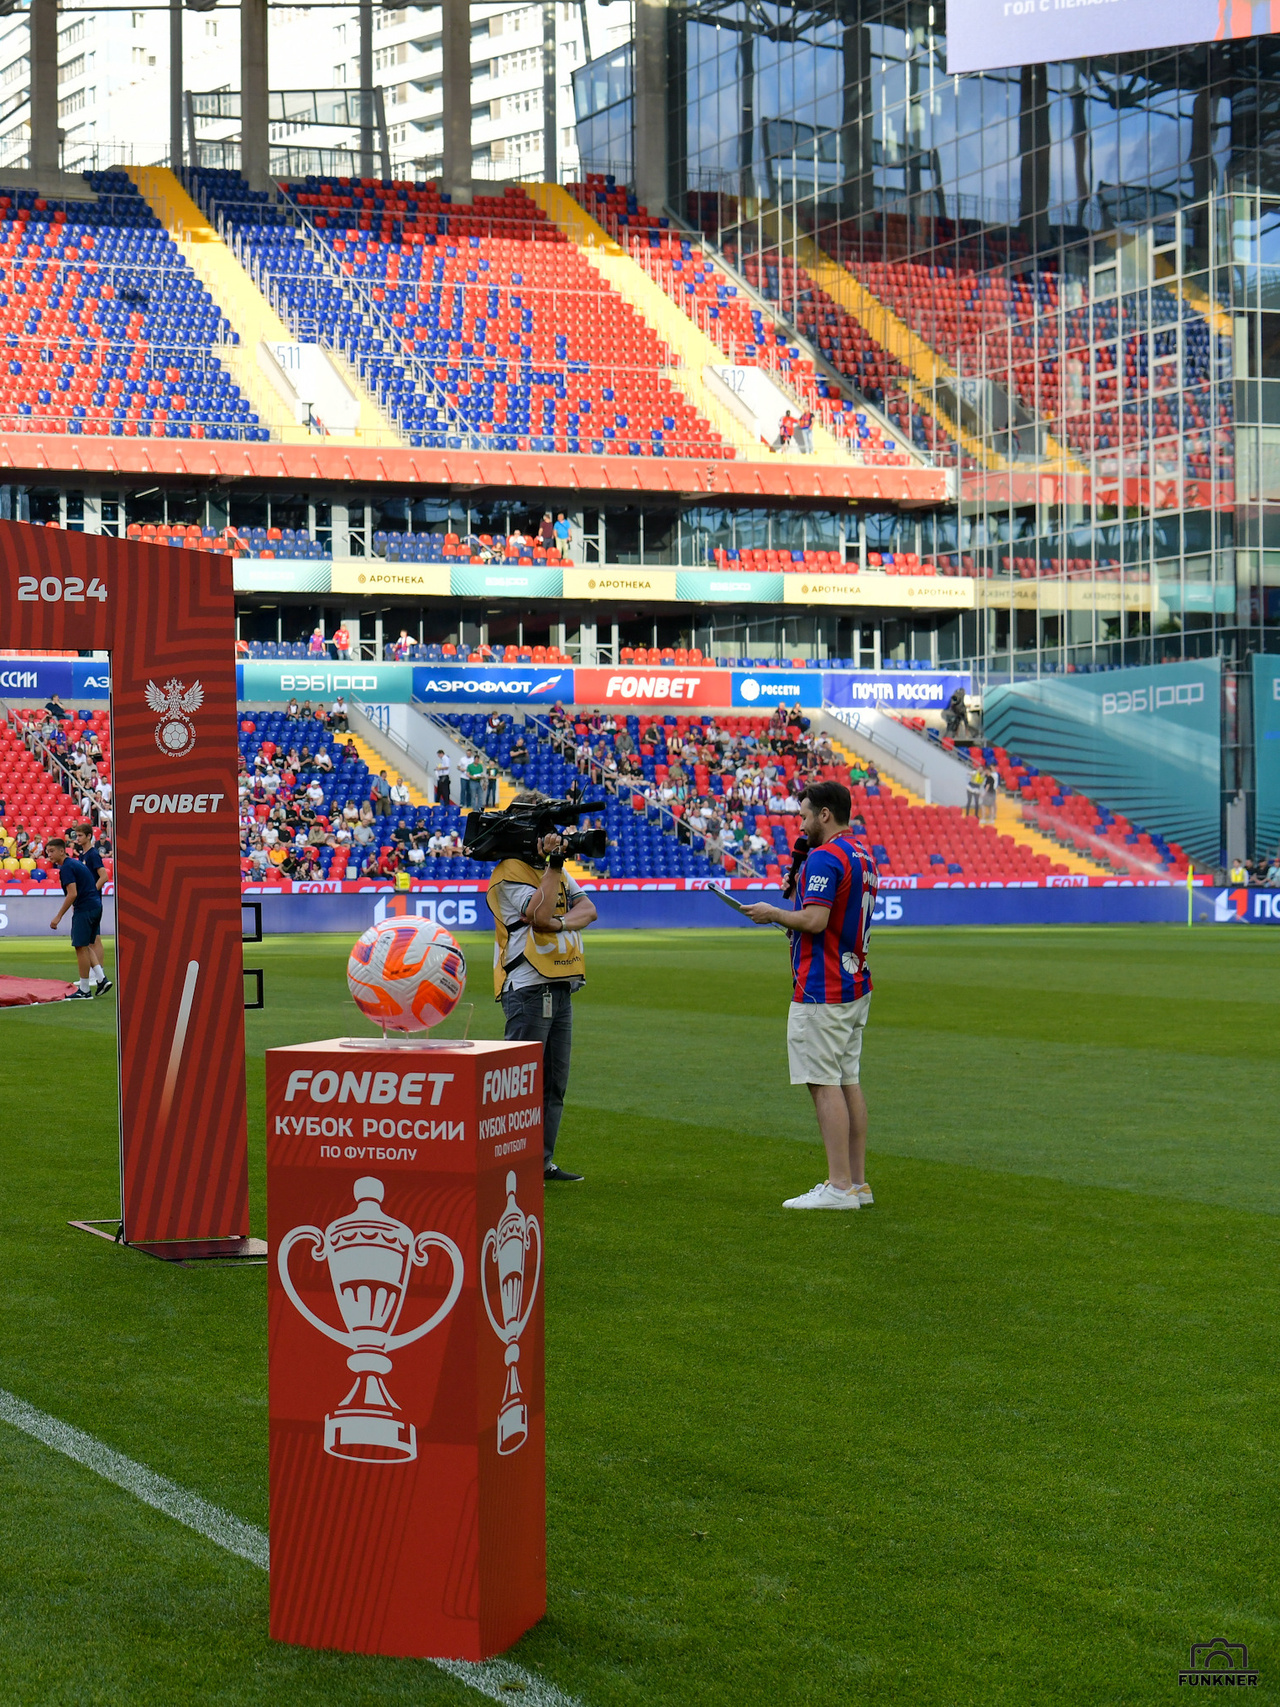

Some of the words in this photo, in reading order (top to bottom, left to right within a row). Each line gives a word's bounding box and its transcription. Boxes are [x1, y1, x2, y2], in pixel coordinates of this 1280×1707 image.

[277, 345, 301, 370] 511
[721, 369, 746, 393] 512
[17, 575, 109, 603] 2024
[369, 575, 425, 584] APOTHEKA
[599, 580, 651, 589] APOTHEKA
[811, 585, 861, 594] APOTHEKA
[425, 680, 532, 693] АЭРОФЛОТ
[606, 676, 700, 699] FONBET
[761, 684, 800, 696] РОССЕТИ
[852, 682, 894, 699] ПОЧТА
[897, 683, 943, 700] РОССИИ
[365, 705, 390, 731] 211
[129, 793, 224, 814] FONBET
[807, 883, 828, 892] BET
[808, 875, 829, 884] FON
[416, 900, 477, 925] ПСБ
[872, 896, 903, 920] СБ
[1254, 893, 1280, 918] ПС
[284, 1069, 454, 1106] FONBET
[482, 1061, 537, 1105] FONBET
[275, 1115, 353, 1137] КУБОК
[363, 1118, 465, 1141] РОССИИ
[479, 1116, 507, 1140] КУБОК
[508, 1106, 541, 1134] РОССИИ
[320, 1145, 341, 1158] ПО
[344, 1146, 417, 1161] ФУТБОЛУ
[494, 1144, 502, 1157] ПО
[502, 1137, 527, 1156] ФУТБОЛУ
